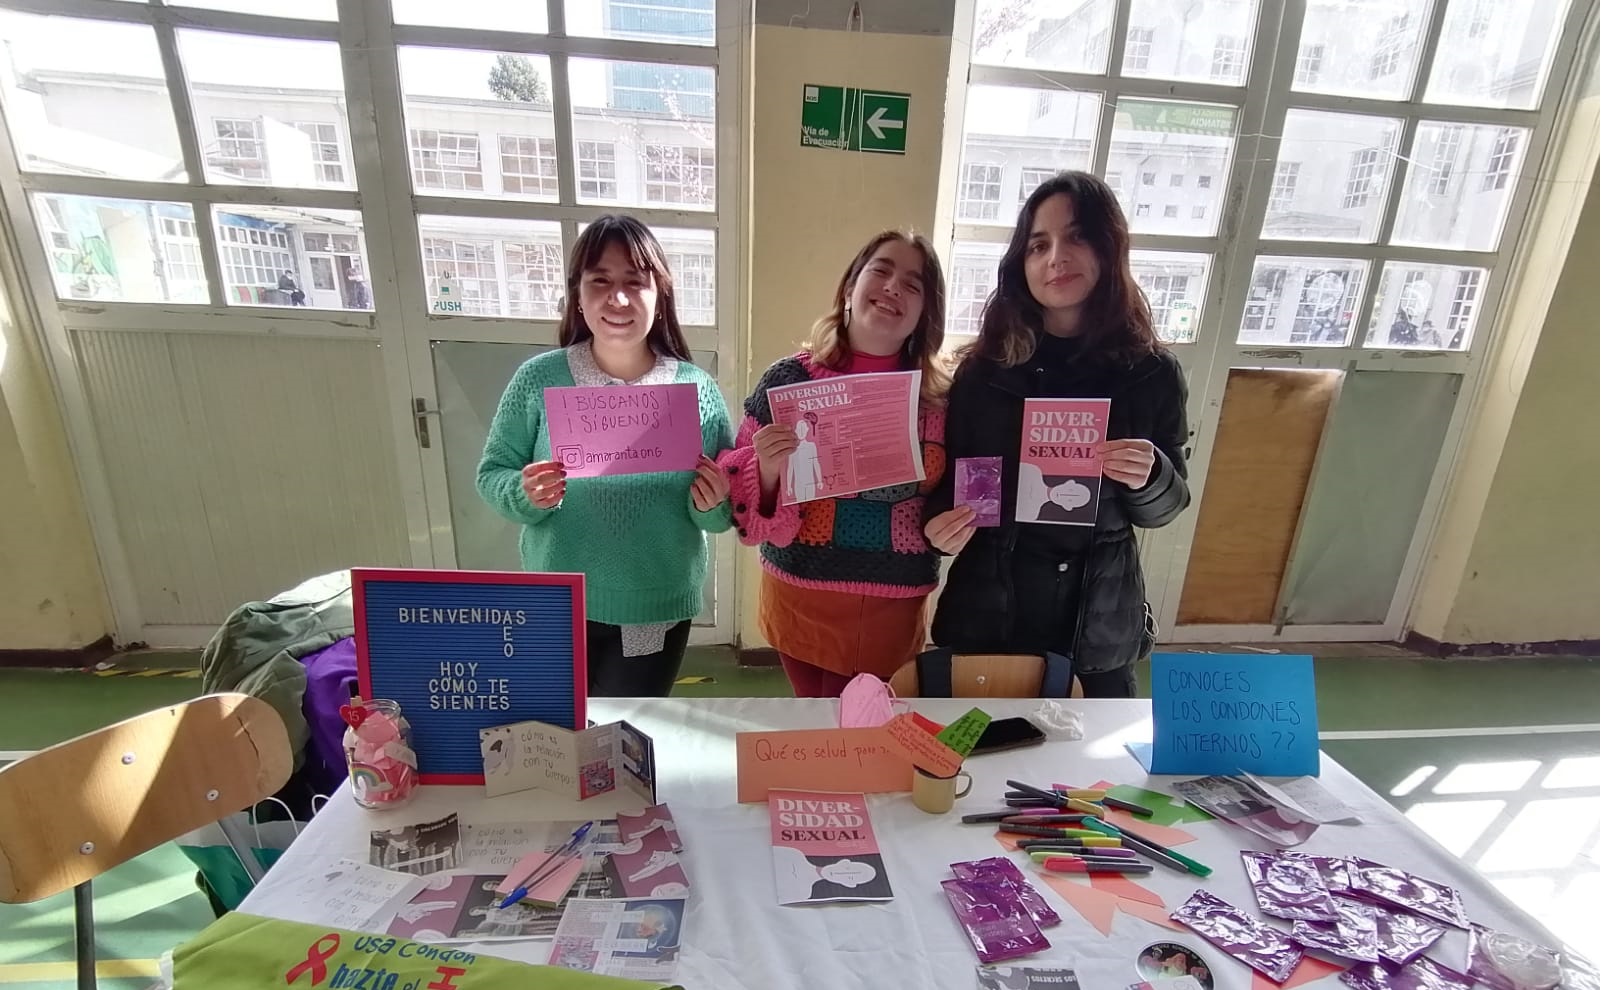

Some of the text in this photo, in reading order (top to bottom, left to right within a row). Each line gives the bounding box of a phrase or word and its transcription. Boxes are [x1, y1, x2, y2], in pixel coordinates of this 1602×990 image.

[818, 127, 830, 136] de
[576, 390, 660, 412] BÚSCANOS
[774, 382, 846, 403] DIVERSIDAD
[798, 392, 852, 412] SEXUAL
[581, 411, 661, 434] SÍGUENOS
[1031, 411, 1102, 427] DIVER-
[1029, 427, 1100, 444] SIDAD
[1028, 445, 1095, 459] SEXUAL
[398, 607, 527, 626] BIENVENIDAS
[440, 661, 479, 677] HOY
[488, 679, 510, 694] TE
[1168, 669, 1251, 693] CONOCES
[430, 695, 511, 711] SIENTES
[348, 710, 360, 722] 15
[1171, 699, 1301, 725] LOS CONDONES
[755, 738, 788, 763] Qué
[792, 747, 807, 760] es
[814, 739, 847, 759] salud
[1172, 731, 1297, 760] INTERNOS ??
[776, 798, 861, 814] DIVER-
[779, 813, 864, 828] SIDAD
[780, 829, 866, 842] SEXUAL
[354, 936, 397, 954] usa
